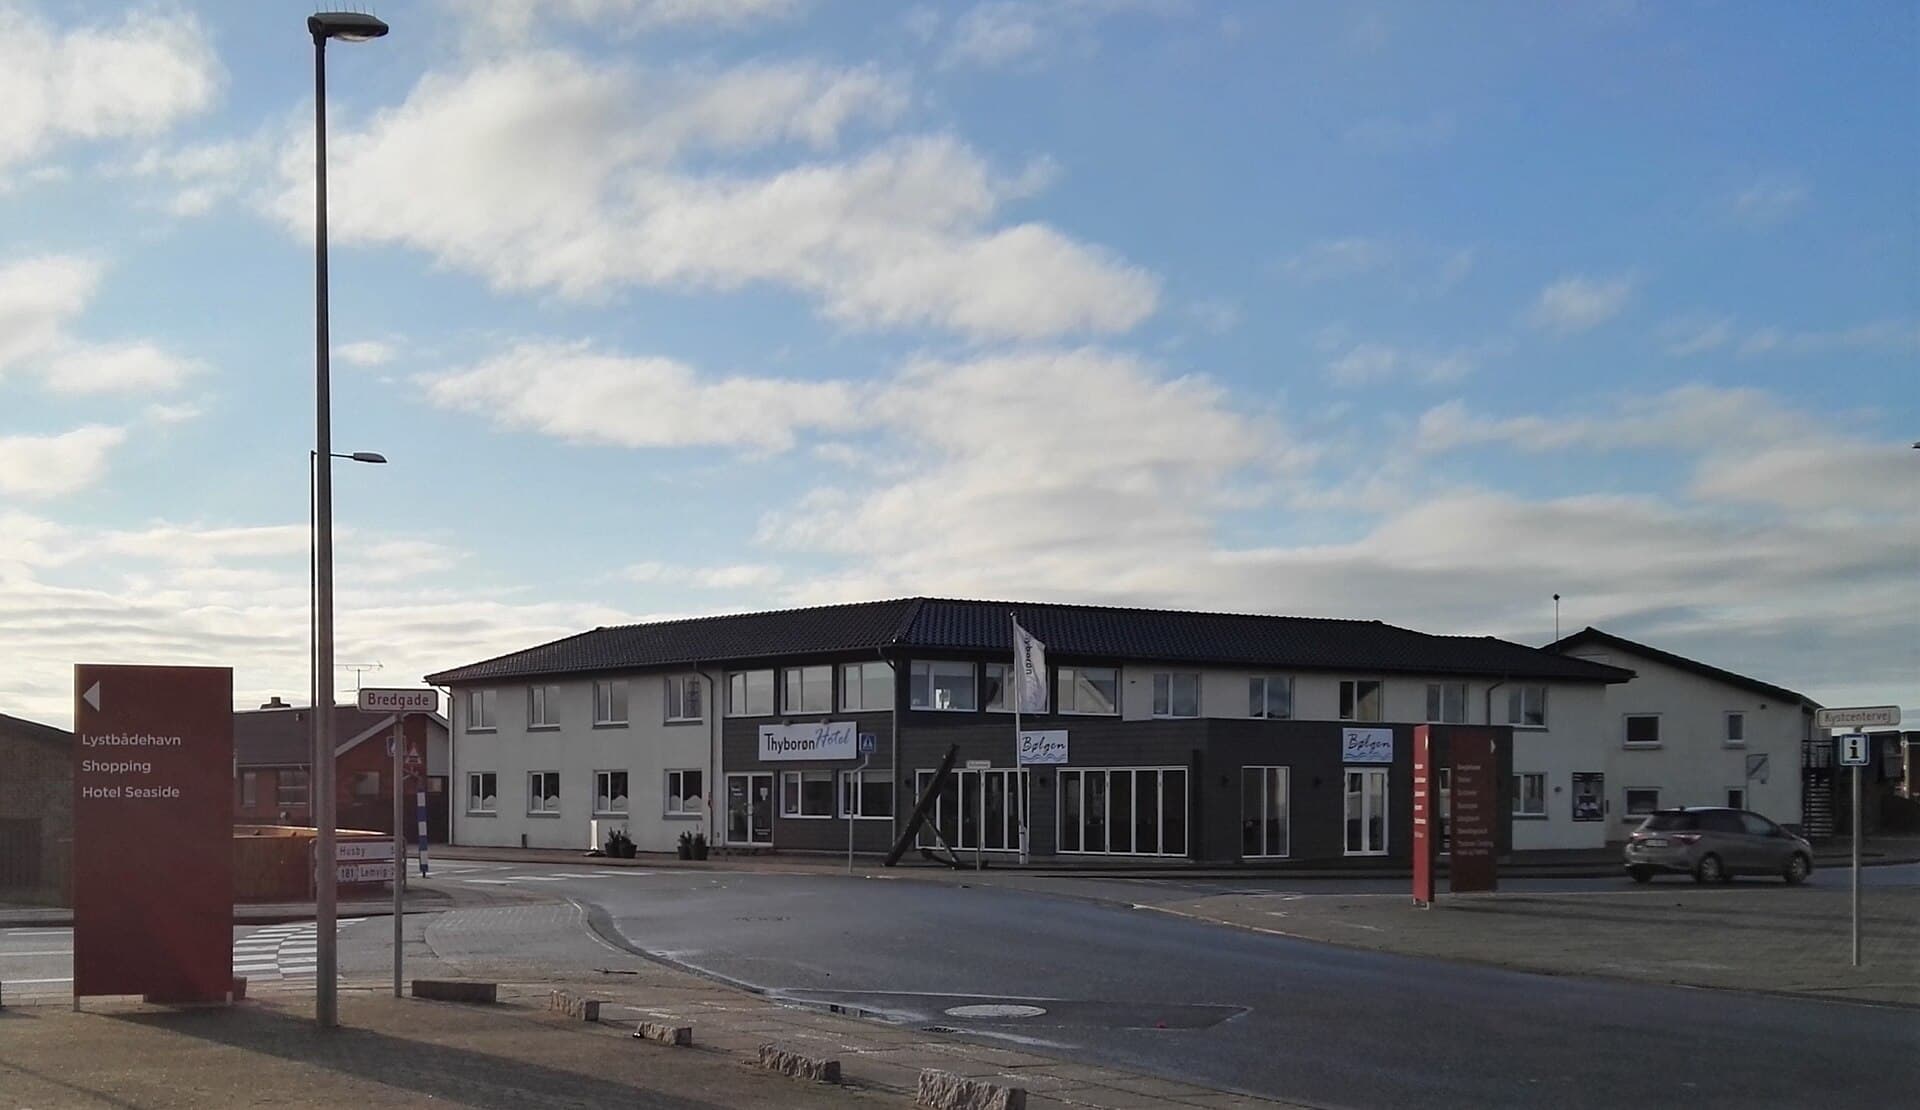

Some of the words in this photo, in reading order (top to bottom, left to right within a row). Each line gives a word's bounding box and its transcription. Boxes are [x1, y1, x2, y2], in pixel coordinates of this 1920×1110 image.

[368, 693, 429, 709] Bredgade
[82, 733, 181, 747] Lystbådehavn
[764, 733, 815, 754] Thyborøn
[815, 727, 851, 749] Hotel
[82, 760, 151, 774] Shopping
[82, 786, 121, 798] Hotel
[125, 785, 180, 798] Seaside
